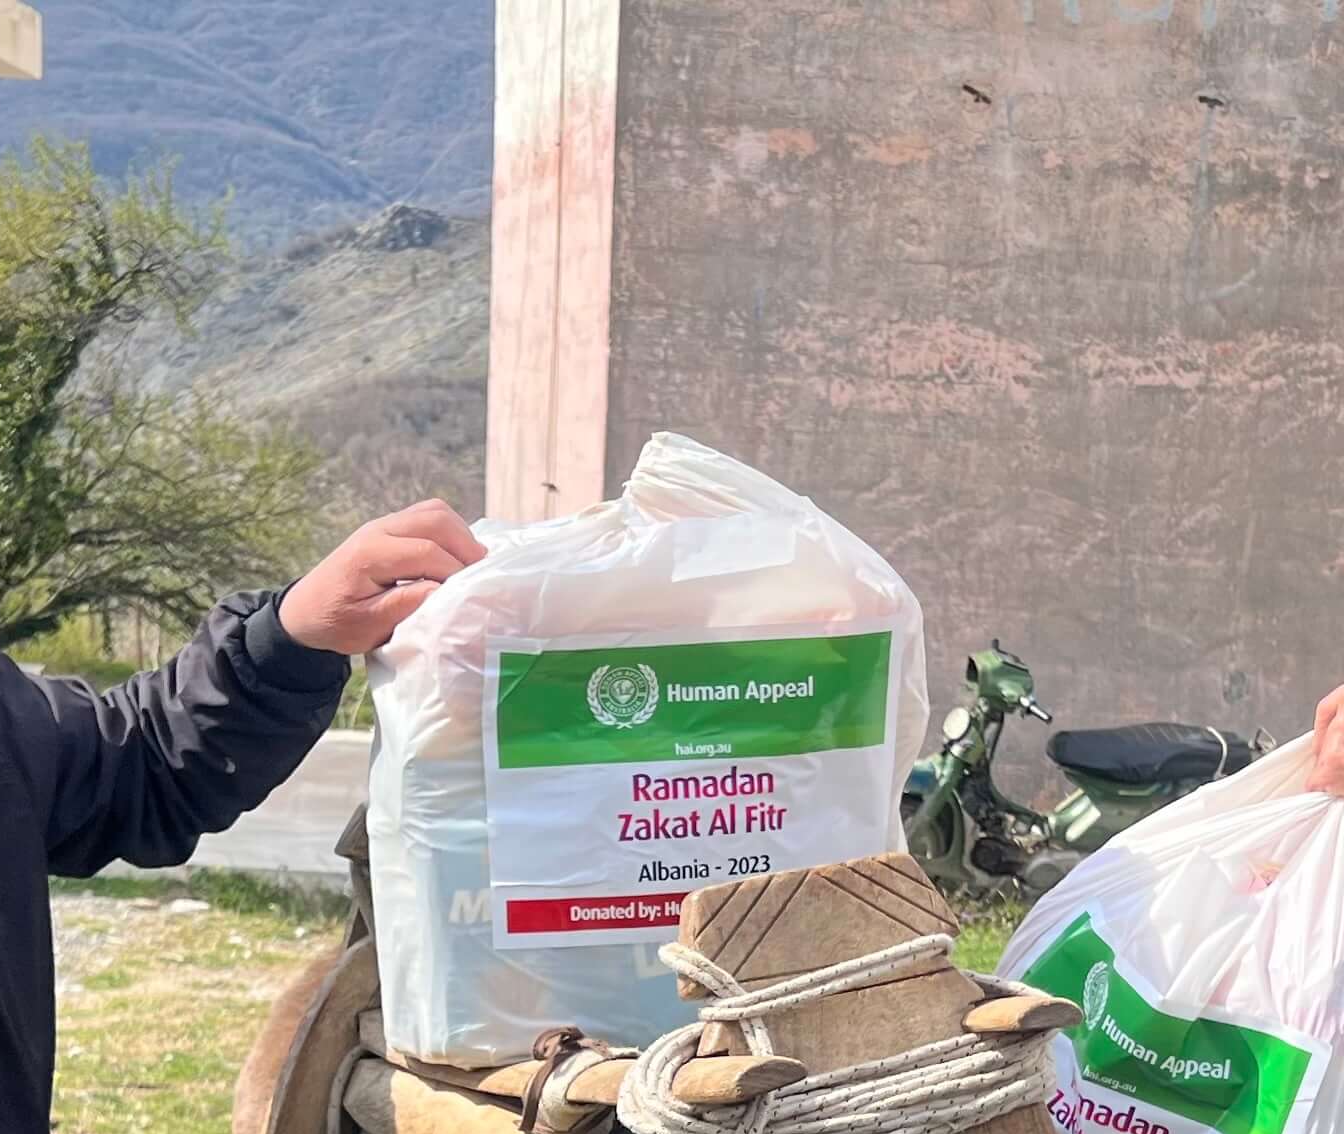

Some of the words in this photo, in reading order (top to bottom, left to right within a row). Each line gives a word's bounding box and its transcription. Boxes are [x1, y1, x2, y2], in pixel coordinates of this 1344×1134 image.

[666, 683, 739, 703] Human
[745, 676, 815, 704] Appeal
[675, 742, 732, 757] hai.org.au
[632, 766, 774, 802] Ramadan
[617, 808, 701, 842] Zakat
[708, 804, 736, 836] Al
[745, 802, 788, 833] Fitr
[638, 858, 710, 883] Albania
[727, 855, 771, 876] 2023
[570, 902, 635, 922] Donated
[638, 902, 662, 922] by:
[1100, 1014, 1158, 1065] Human
[1160, 1056, 1232, 1080] Appeal
